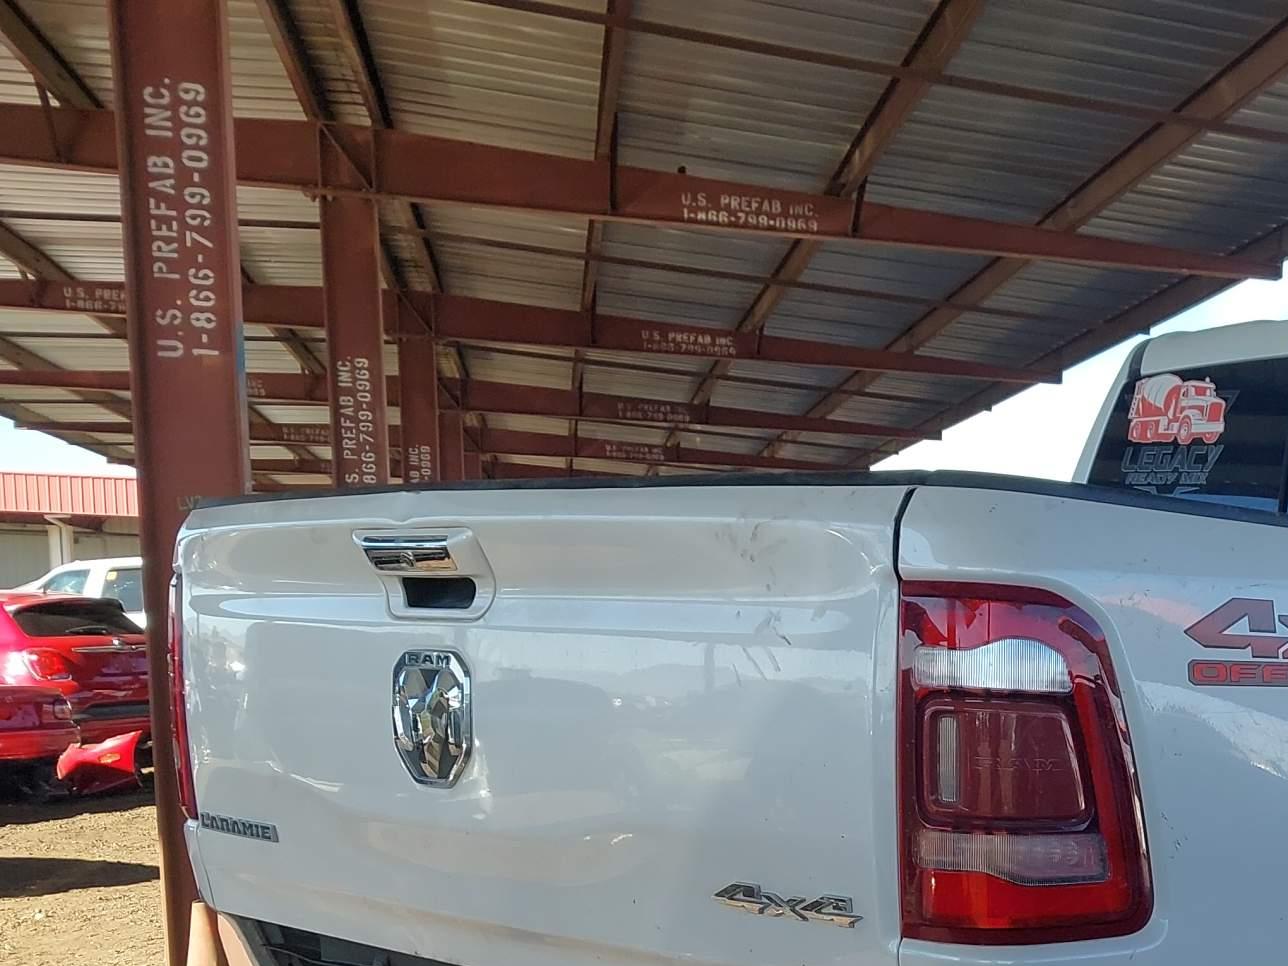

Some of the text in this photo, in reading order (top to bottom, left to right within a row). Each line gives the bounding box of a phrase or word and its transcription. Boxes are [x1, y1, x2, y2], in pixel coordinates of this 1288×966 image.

[143, 78, 184, 358] U.S. PREFAB INC.
[681, 191, 712, 207] U.S.
[720, 194, 782, 214] PREFAB
[179, 82, 219, 356] 1-866-799-0969
[336, 356, 353, 387] INC.
[339, 396, 357, 459] PREFAB
[354, 358, 377, 483] 866-799-0969
[1121, 444, 1225, 472] LEGACY
[405, 651, 451, 667] RAM
[200, 811, 273, 841] LARAMIE
